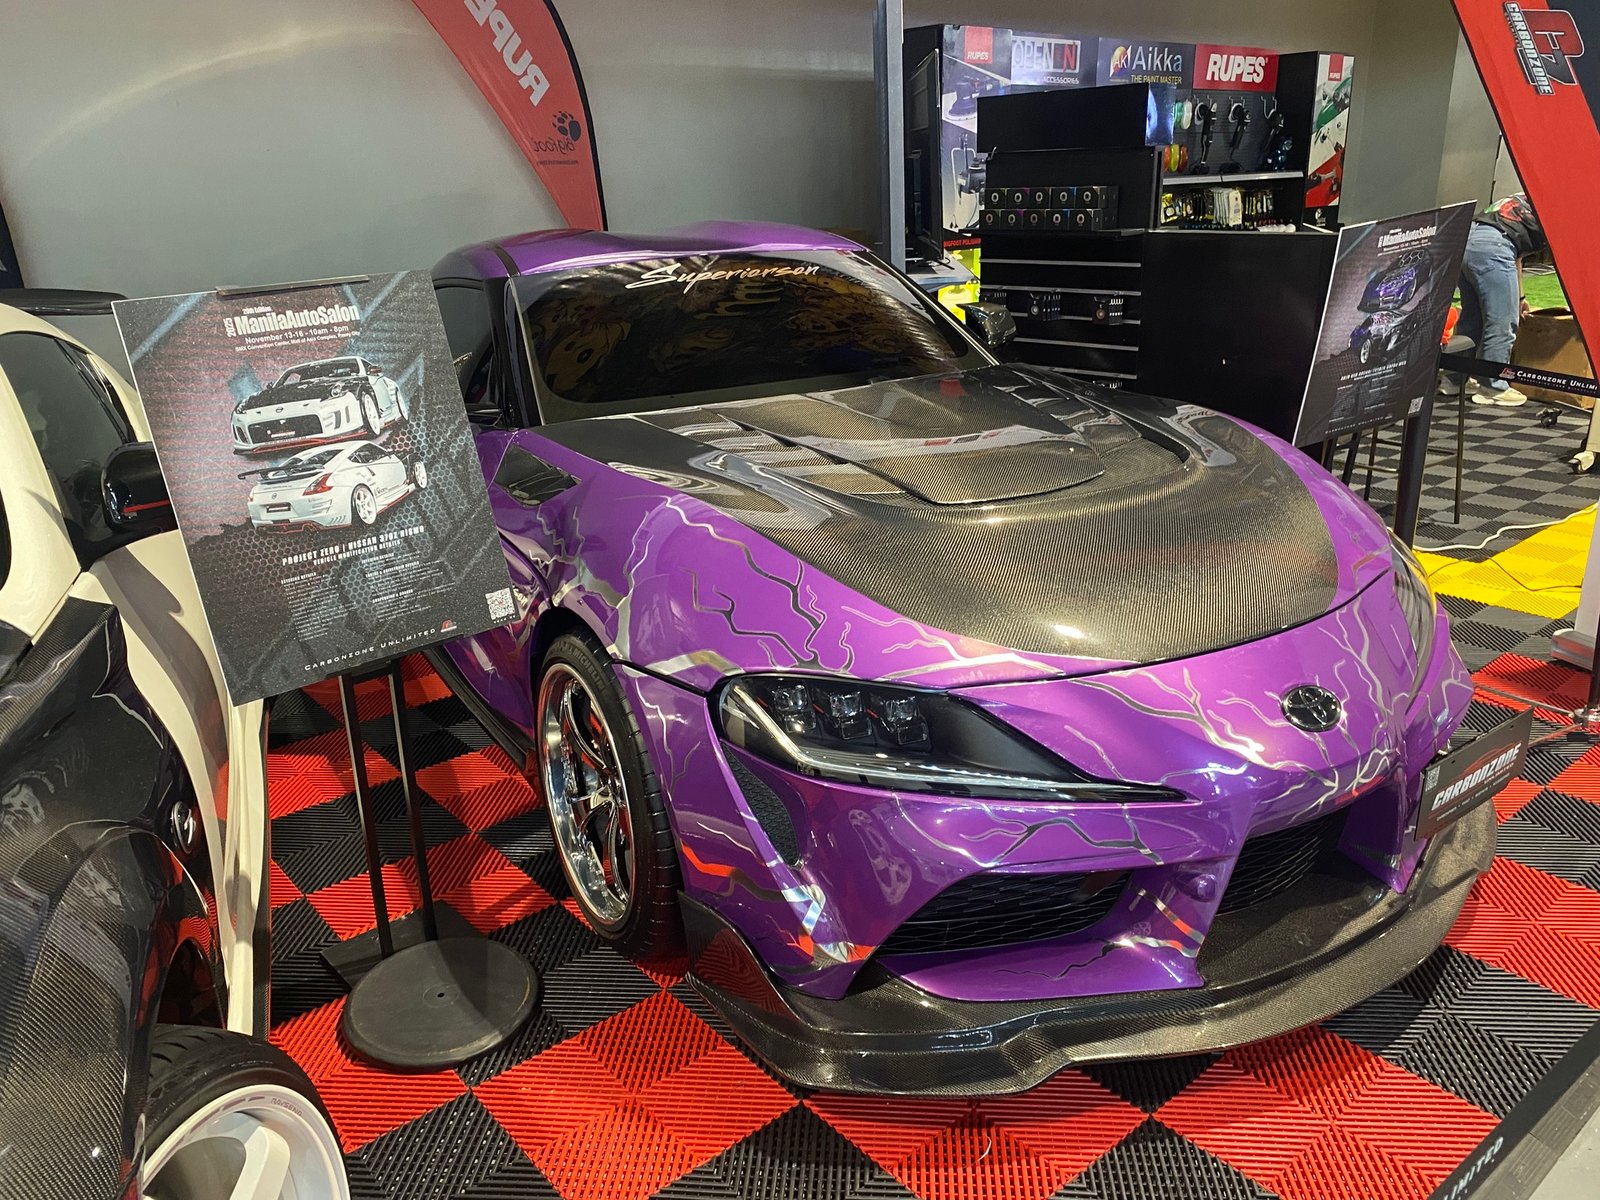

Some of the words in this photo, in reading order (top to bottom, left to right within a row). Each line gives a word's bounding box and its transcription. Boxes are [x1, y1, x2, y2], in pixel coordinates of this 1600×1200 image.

[967, 51, 989, 61] RUPES
[1132, 46, 1182, 72] Aikka
[1506, 3, 1553, 94] CARBONZONE
[1131, 75, 1143, 84] THE
[1143, 75, 1159, 84] PAINT
[1160, 76, 1183, 85] MASTER
[1206, 53, 1266, 84] RUPES
[223, 317, 236, 337] 2025
[234, 304, 360, 335] ManilaAutoSalon
[245, 335, 282, 345] November
[284, 330, 303, 338] 13-16
[309, 328, 328, 336] 10am
[334, 325, 349, 334] 8pm
[1517, 371, 1567, 385] CARBONZONE
[282, 551, 318, 566] PROJECT
[320, 546, 340, 557] ZERO
[348, 537, 378, 550] NISSAN
[400, 525, 425, 538] NISMO
[304, 645, 375, 671] CARBONZONE
[380, 627, 436, 648] UNLIMITED
[1432, 743, 1521, 811] CARBONZONE
[1443, 1136, 1504, 1200] IMITED
